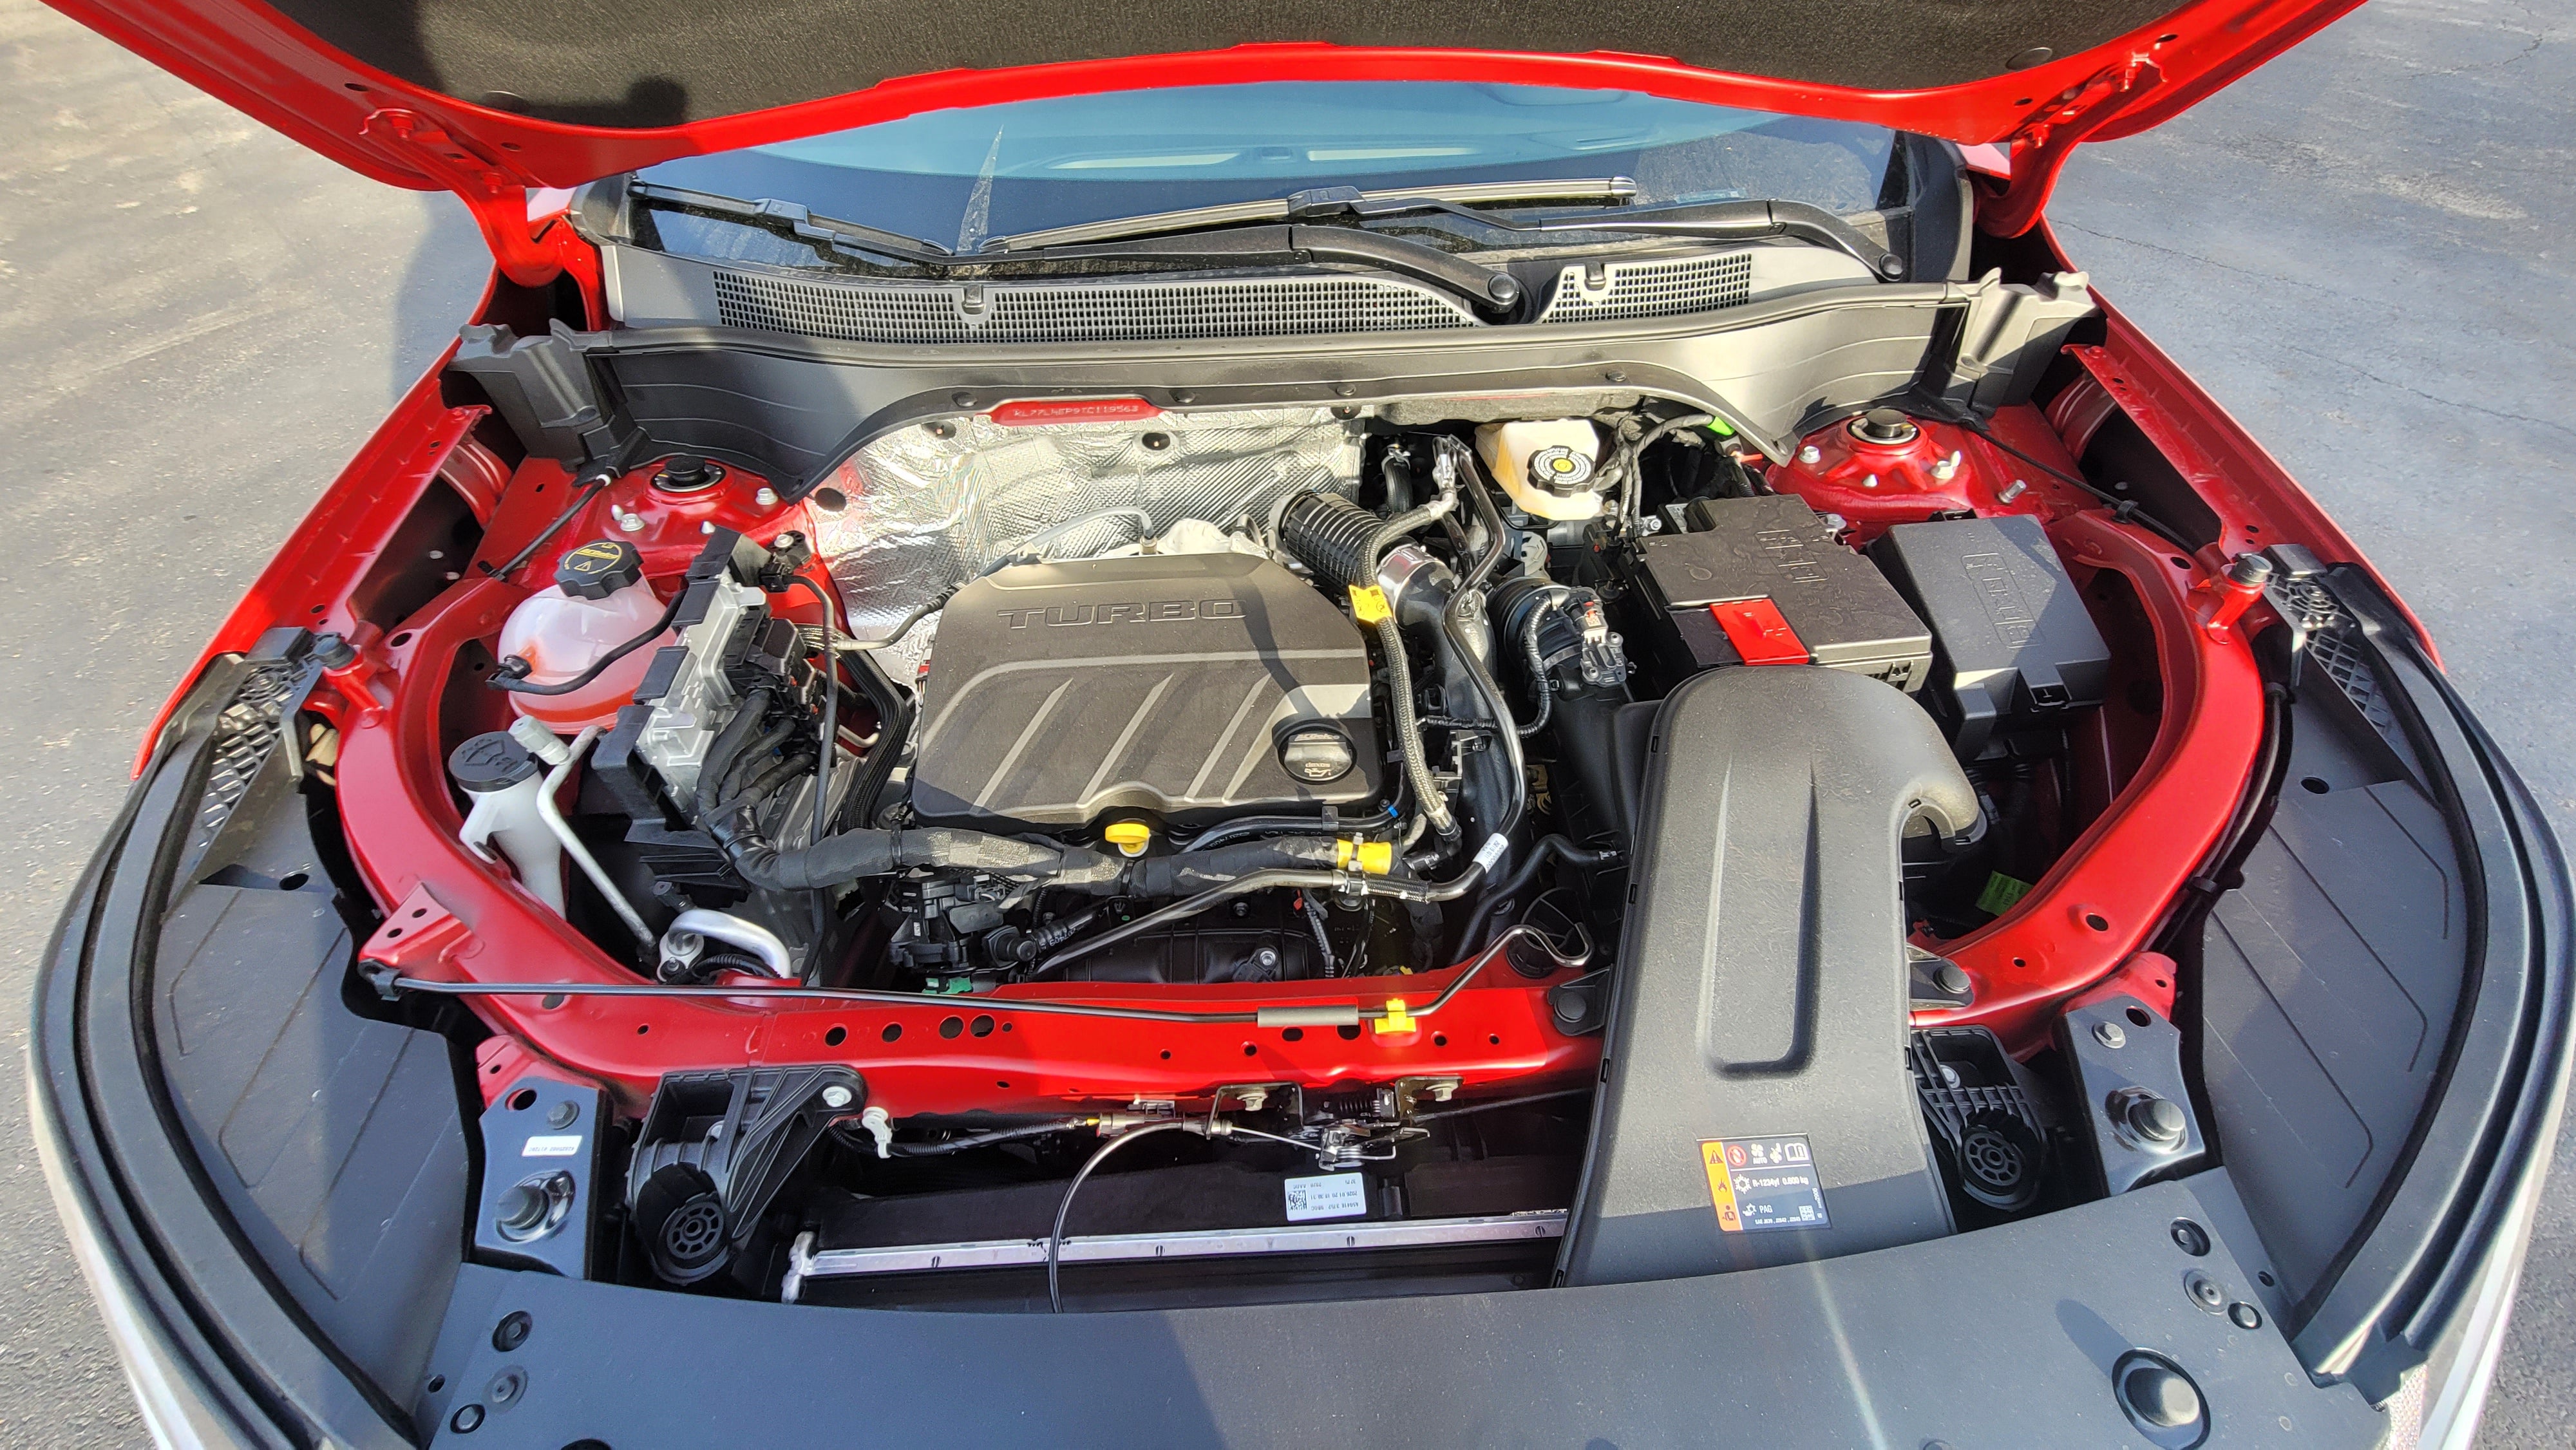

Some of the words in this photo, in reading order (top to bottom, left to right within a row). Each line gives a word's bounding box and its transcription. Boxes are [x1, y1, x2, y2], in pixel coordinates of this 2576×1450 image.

[998, 599, 1247, 630] TURBO
[1800, 1176, 1809, 1185] kg
[1759, 1205, 1773, 1214] PAG
